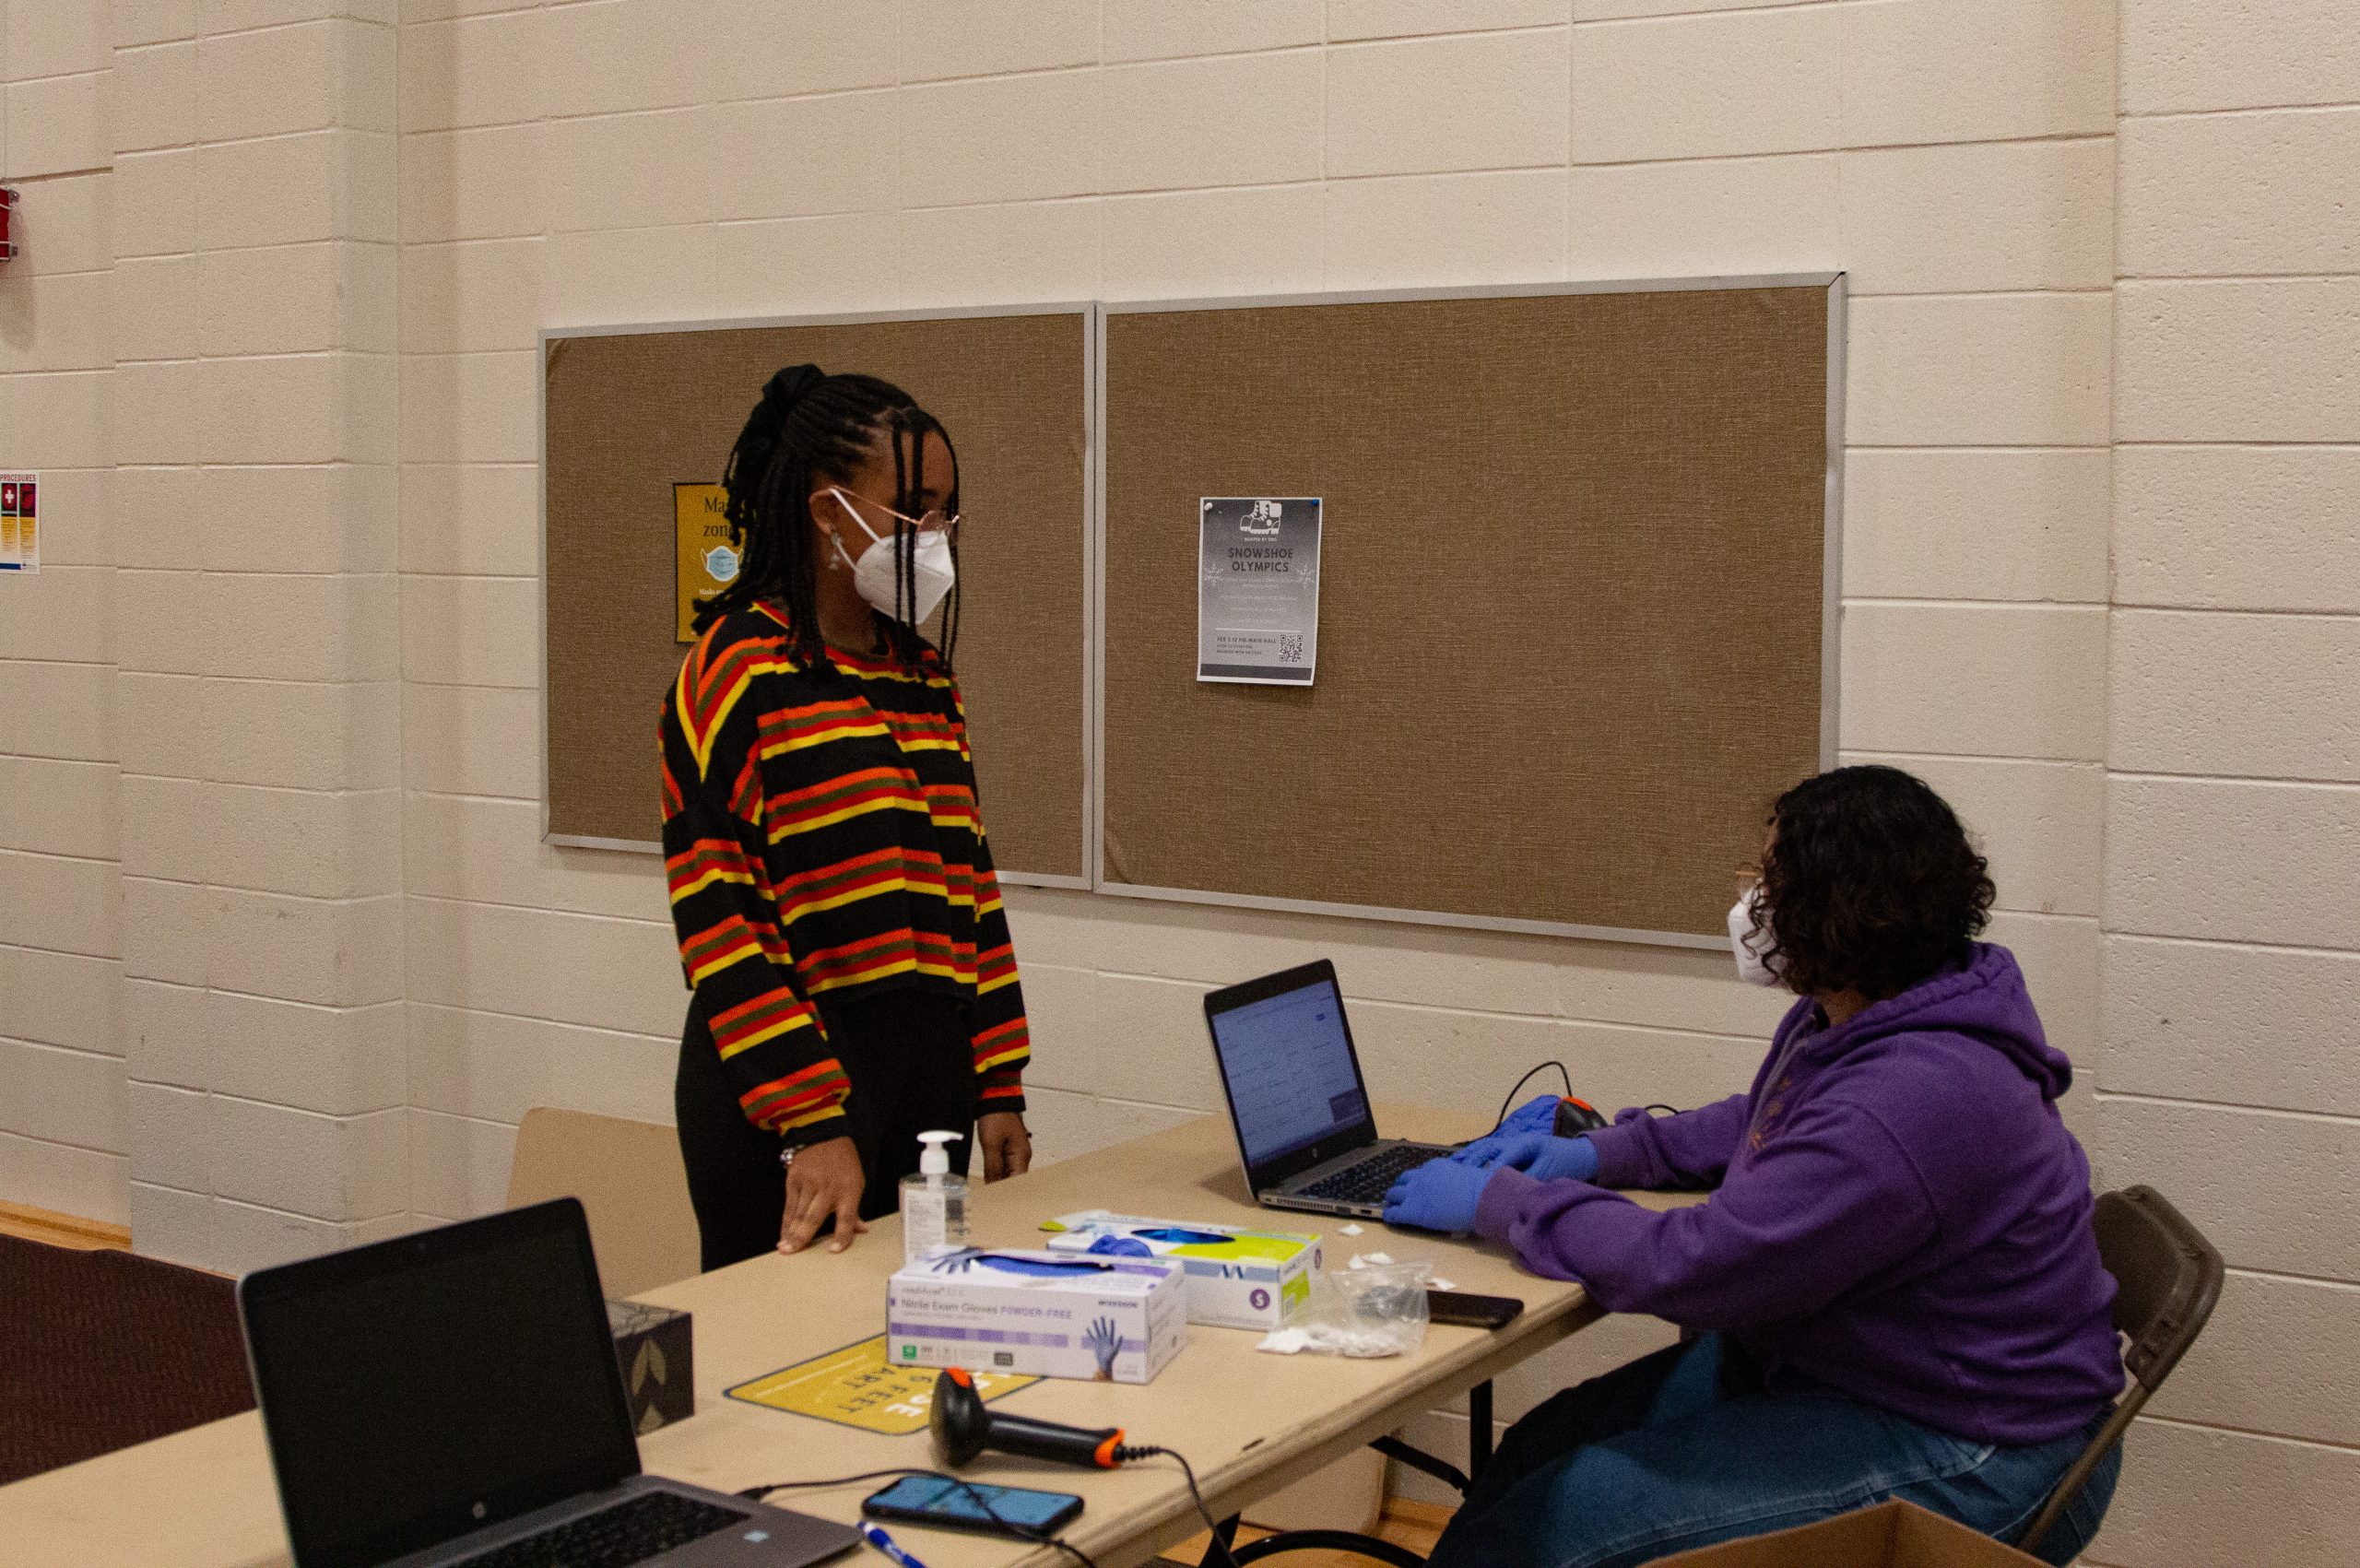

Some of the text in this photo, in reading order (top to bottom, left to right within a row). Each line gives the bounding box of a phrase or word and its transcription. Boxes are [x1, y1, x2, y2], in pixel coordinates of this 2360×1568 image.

[1228, 548, 1293, 559] SNOWSHOE
[1232, 560, 1290, 572] OLYMPICS
[902, 1299, 929, 1310] Nitrile
[932, 1301, 959, 1311] Exam
[961, 1303, 997, 1315] Gloves
